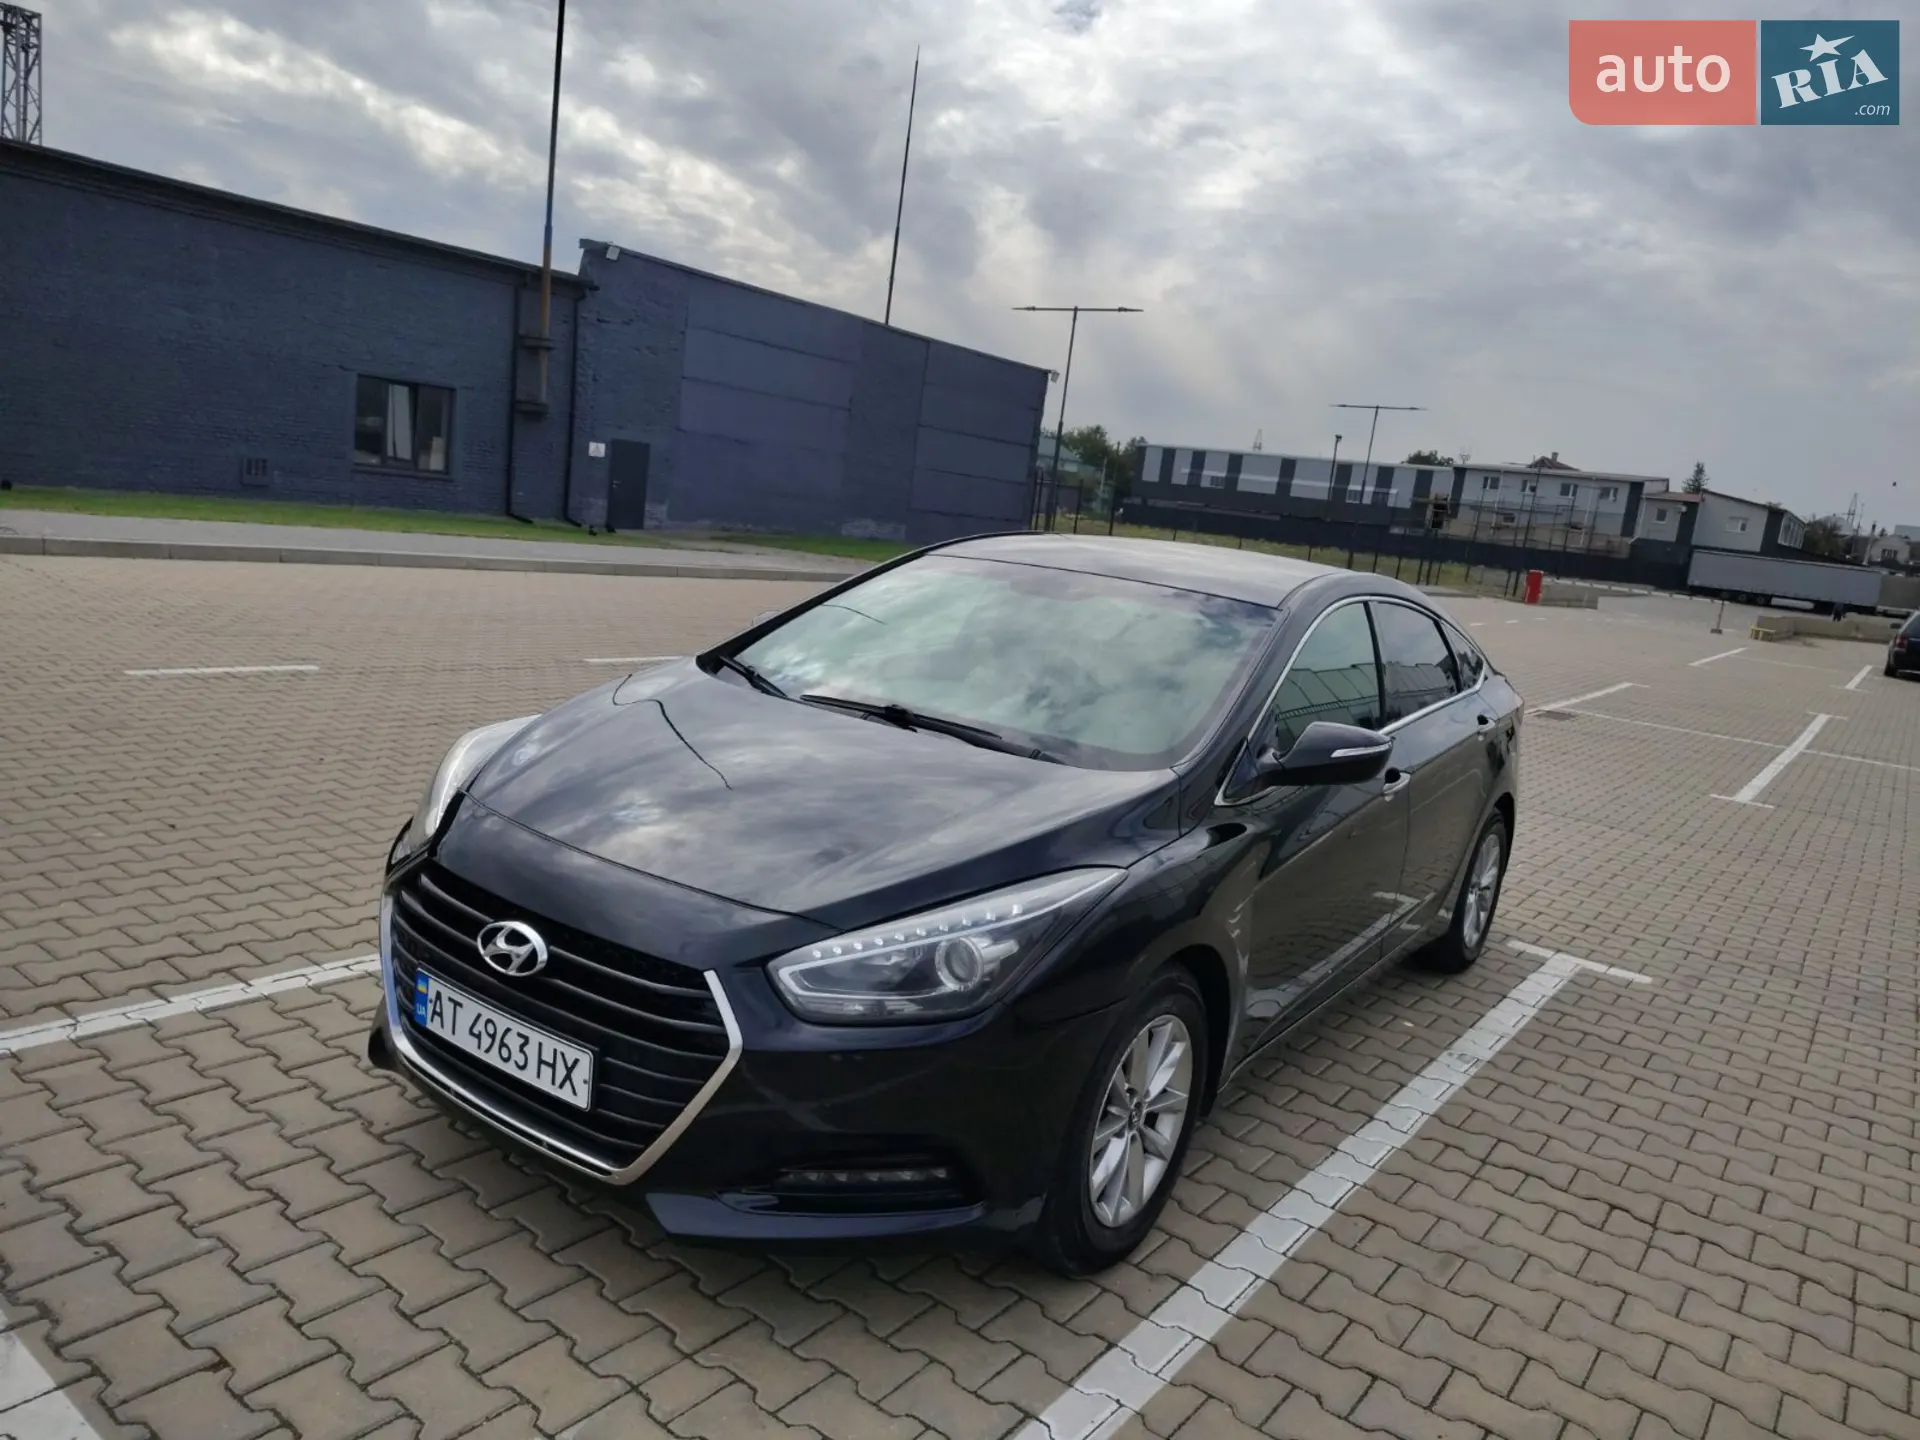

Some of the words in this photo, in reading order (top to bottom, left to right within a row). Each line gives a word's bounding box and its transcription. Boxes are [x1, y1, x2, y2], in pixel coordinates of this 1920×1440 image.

[416, 1004, 427, 1017] UA
[430, 989, 463, 1036] AT
[468, 1012, 530, 1072] 4963
[536, 1041, 580, 1097] HX
